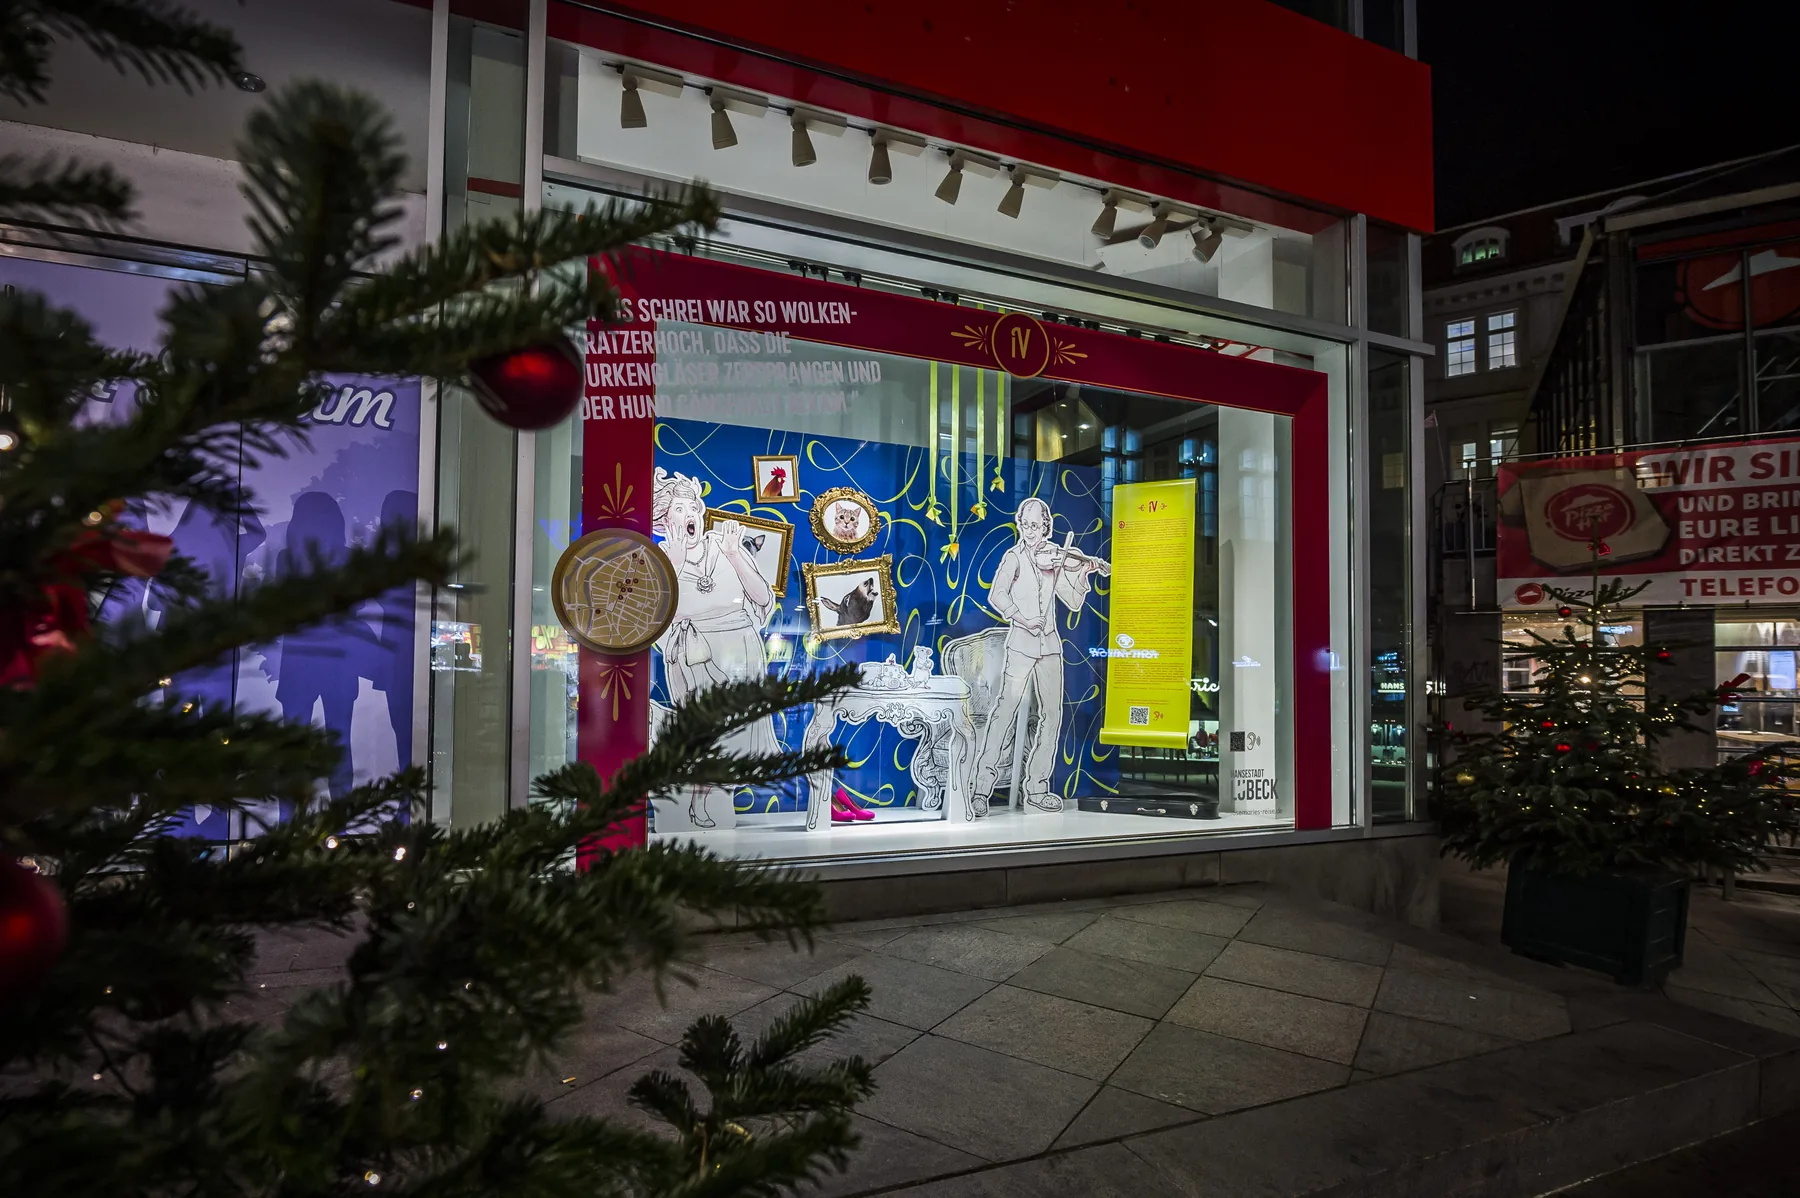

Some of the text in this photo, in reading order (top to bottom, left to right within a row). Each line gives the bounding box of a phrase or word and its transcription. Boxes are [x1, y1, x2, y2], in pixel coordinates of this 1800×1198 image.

[637, 298, 703, 323] SCHREI
[706, 299, 751, 323] WAR
[753, 300, 777, 324] SO
[779, 300, 858, 324] WOLKEN-
[713, 331, 760, 354] DASS
[764, 331, 792, 354] DIE
[584, 359, 719, 387] URKENGLÄSER
[847, 360, 882, 384] UND
[578, 395, 616, 420] DER
[1651, 449, 1800, 485] WIR SI
[1678, 494, 1735, 513] UND
[1565, 503, 1616, 528] Pizza
[1679, 517, 1760, 539] EURE
[1680, 545, 1778, 565] DIREKT
[1679, 576, 1799, 597] TELEFO
[1231, 778, 1279, 801] LÜBECK
